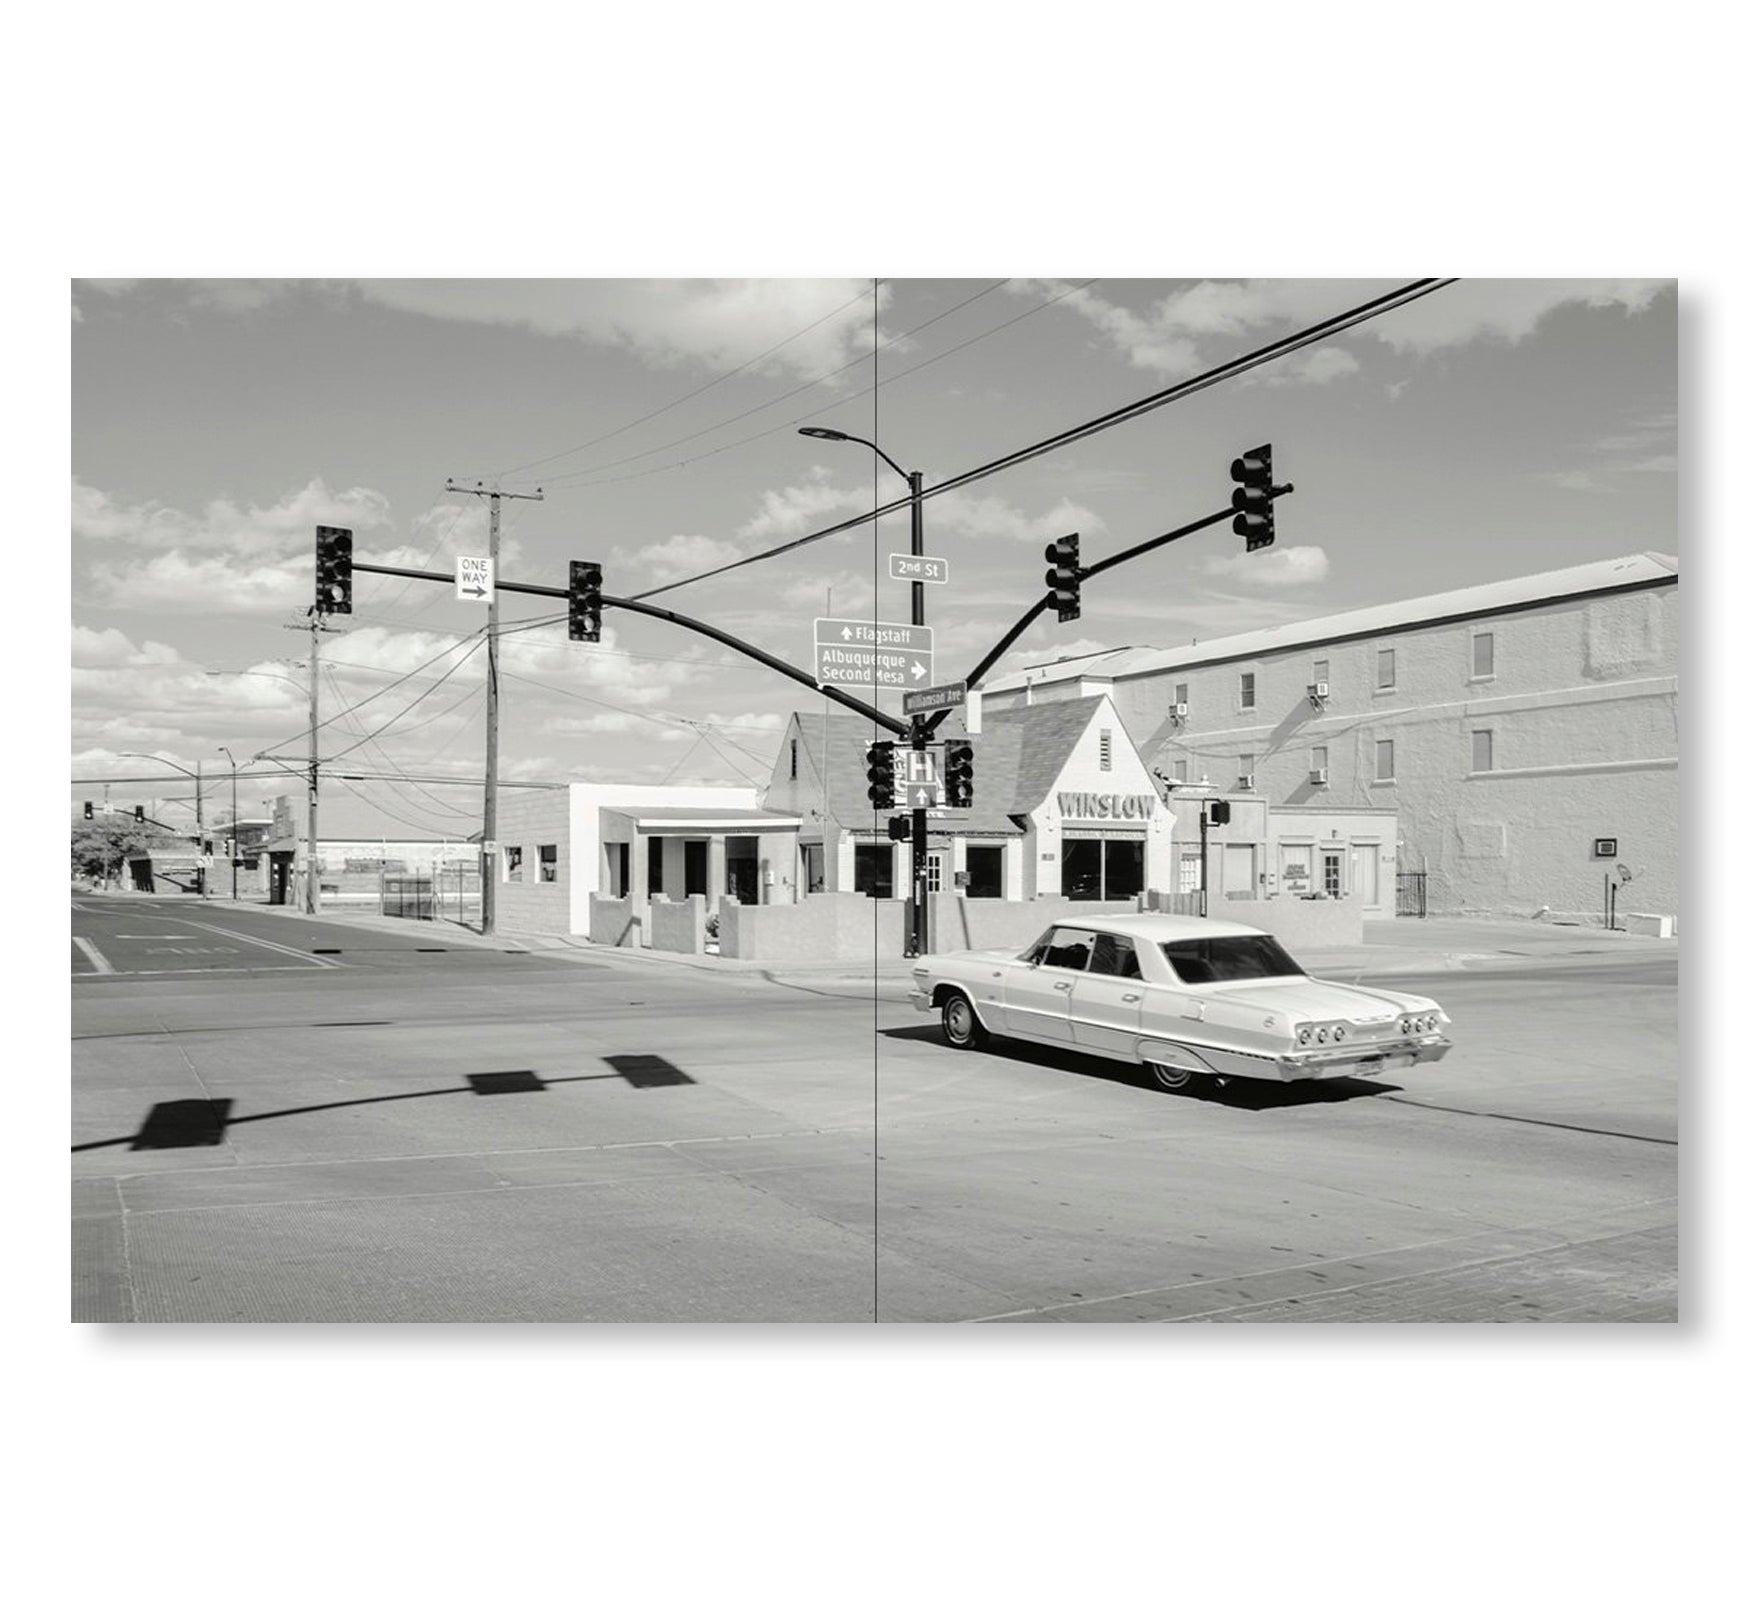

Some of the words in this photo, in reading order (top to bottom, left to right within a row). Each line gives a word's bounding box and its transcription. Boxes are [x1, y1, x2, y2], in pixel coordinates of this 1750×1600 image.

[462, 558, 487, 571] ONE
[898, 560, 920, 574] 2nd
[924, 563, 939, 577] St
[462, 571, 488, 584] WAY
[856, 626, 910, 645] Flagstaff
[822, 649, 906, 670] Albuquerque
[822, 666, 871, 681] Second
[906, 691, 946, 710] Williamson
[909, 752, 934, 782] H
[1057, 792, 1156, 820] WINSLOW
